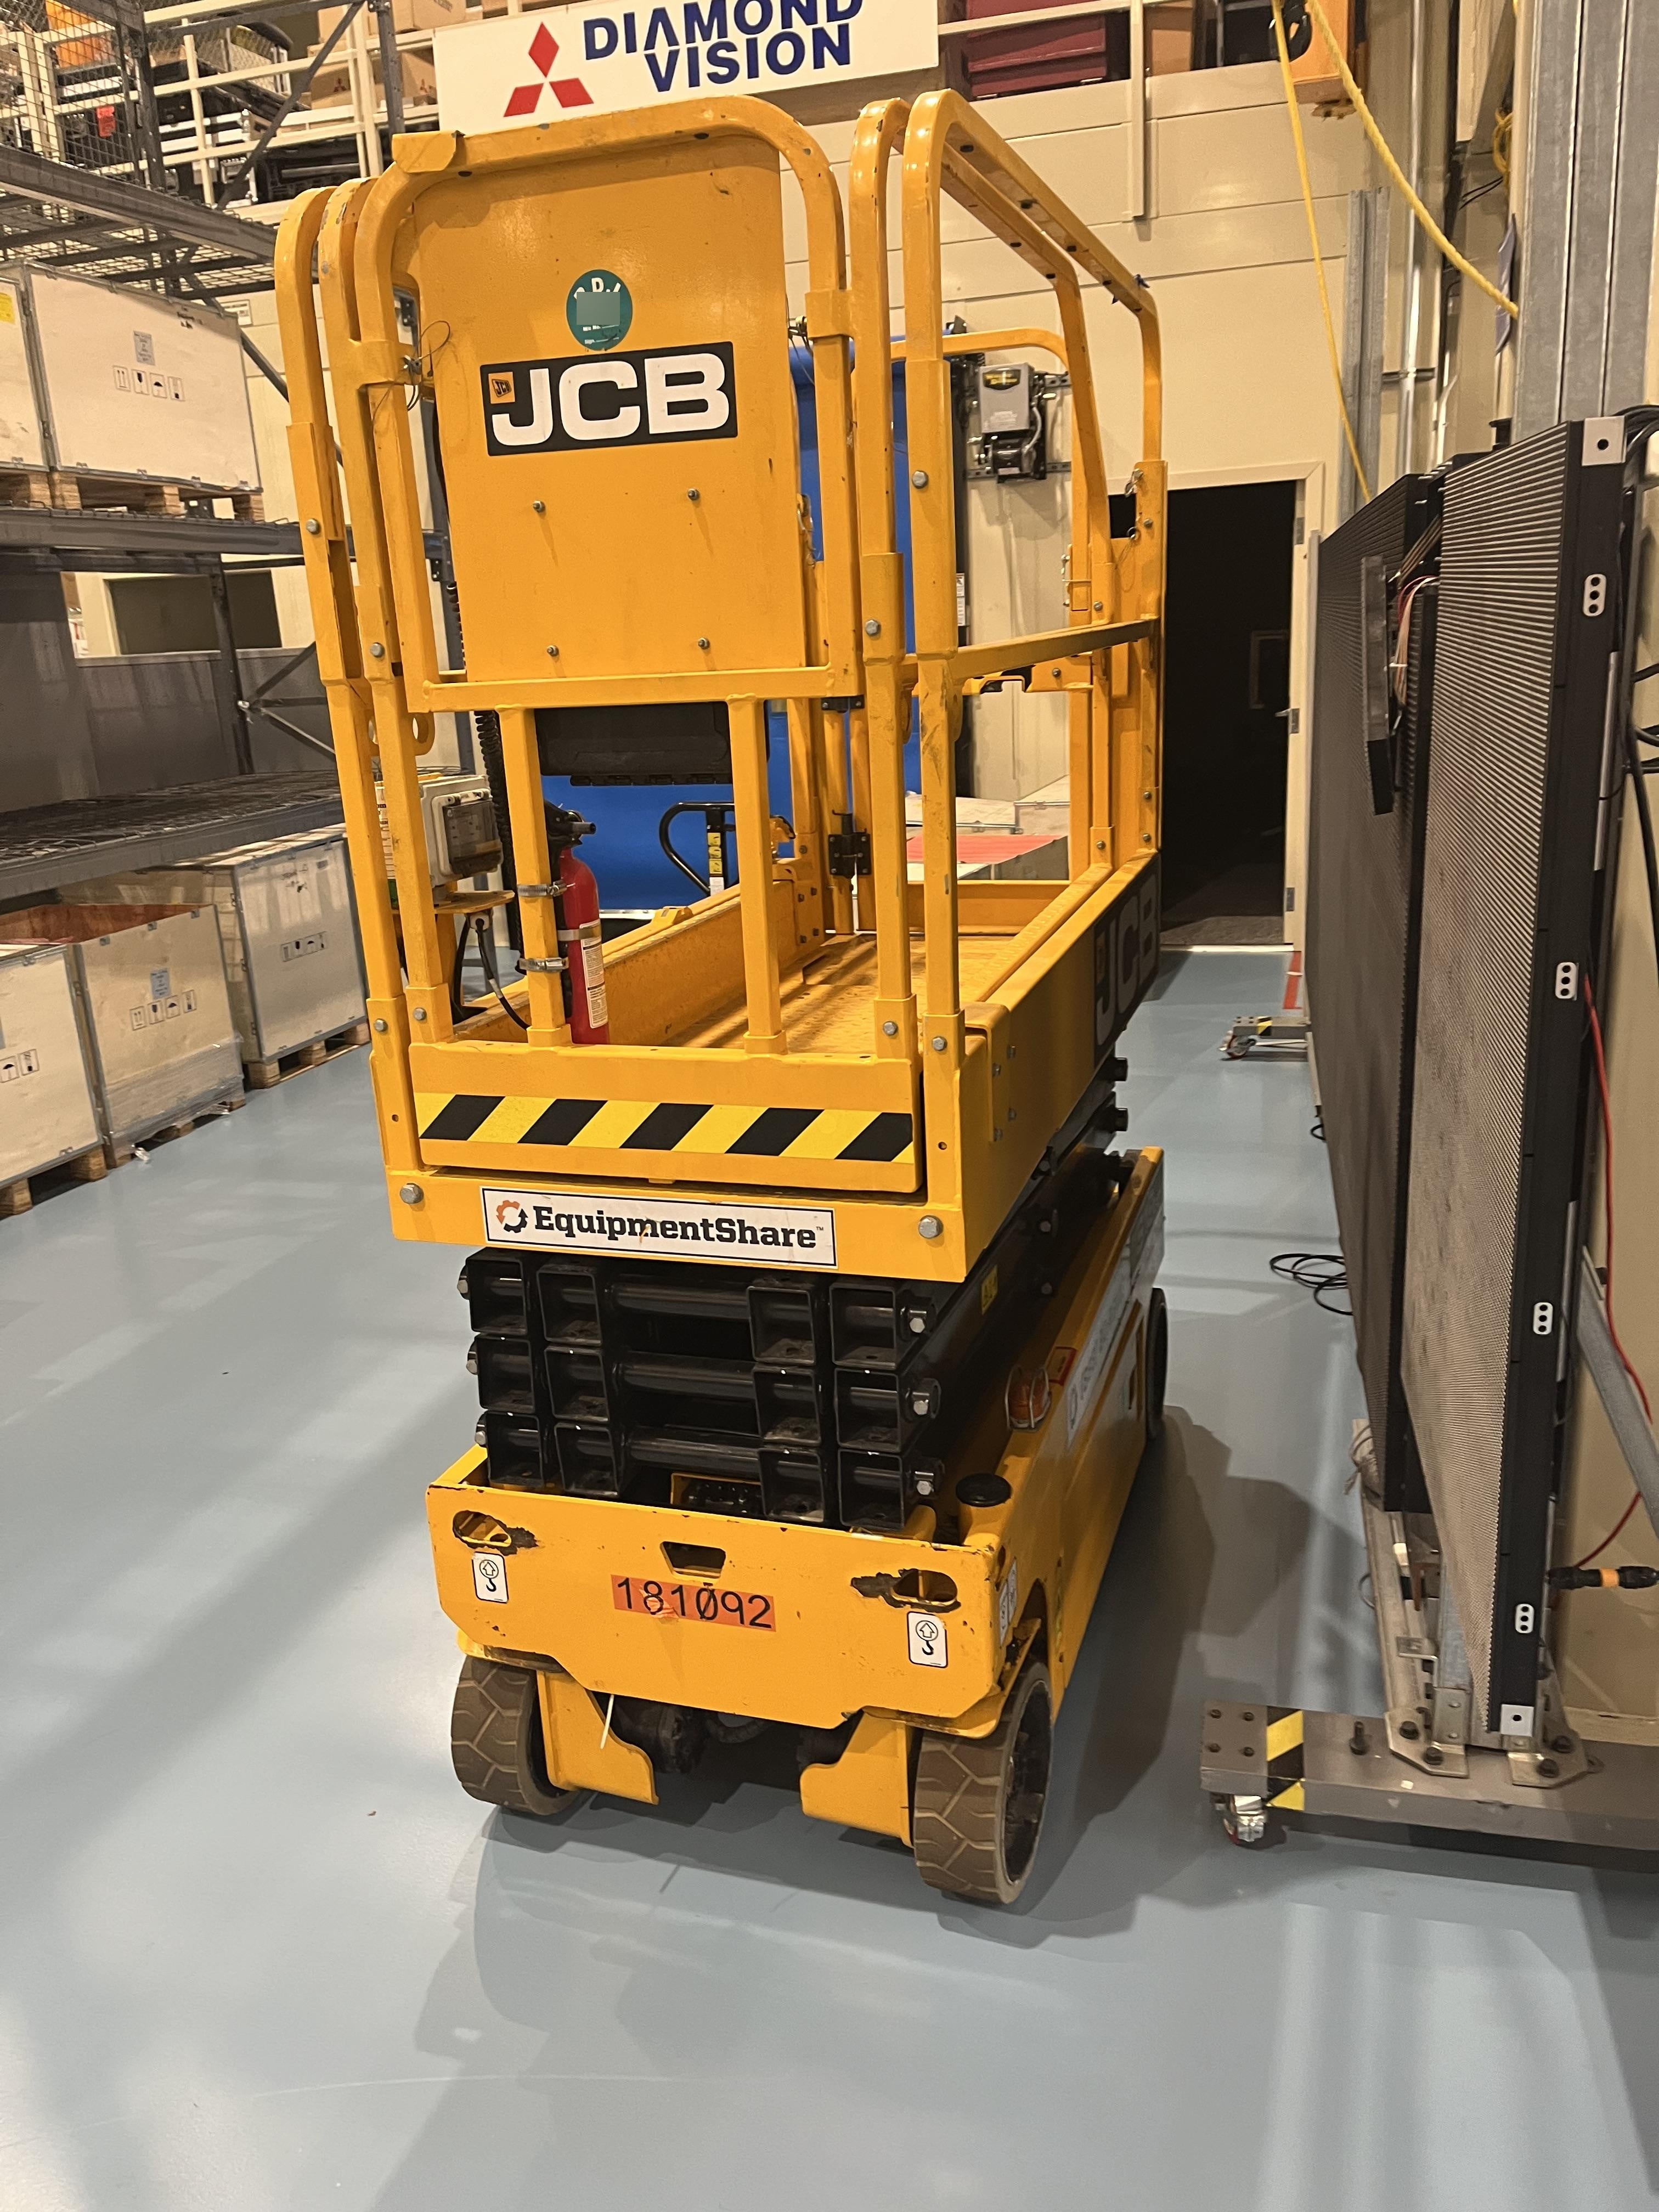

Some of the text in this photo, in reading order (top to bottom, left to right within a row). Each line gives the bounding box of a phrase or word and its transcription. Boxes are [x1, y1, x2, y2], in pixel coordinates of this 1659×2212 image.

[644, 23, 851, 92] VISION
[492, 353, 730, 446] JCB
[1096, 874, 1157, 1046] JCB
[617, 1577, 772, 1629] 181092
